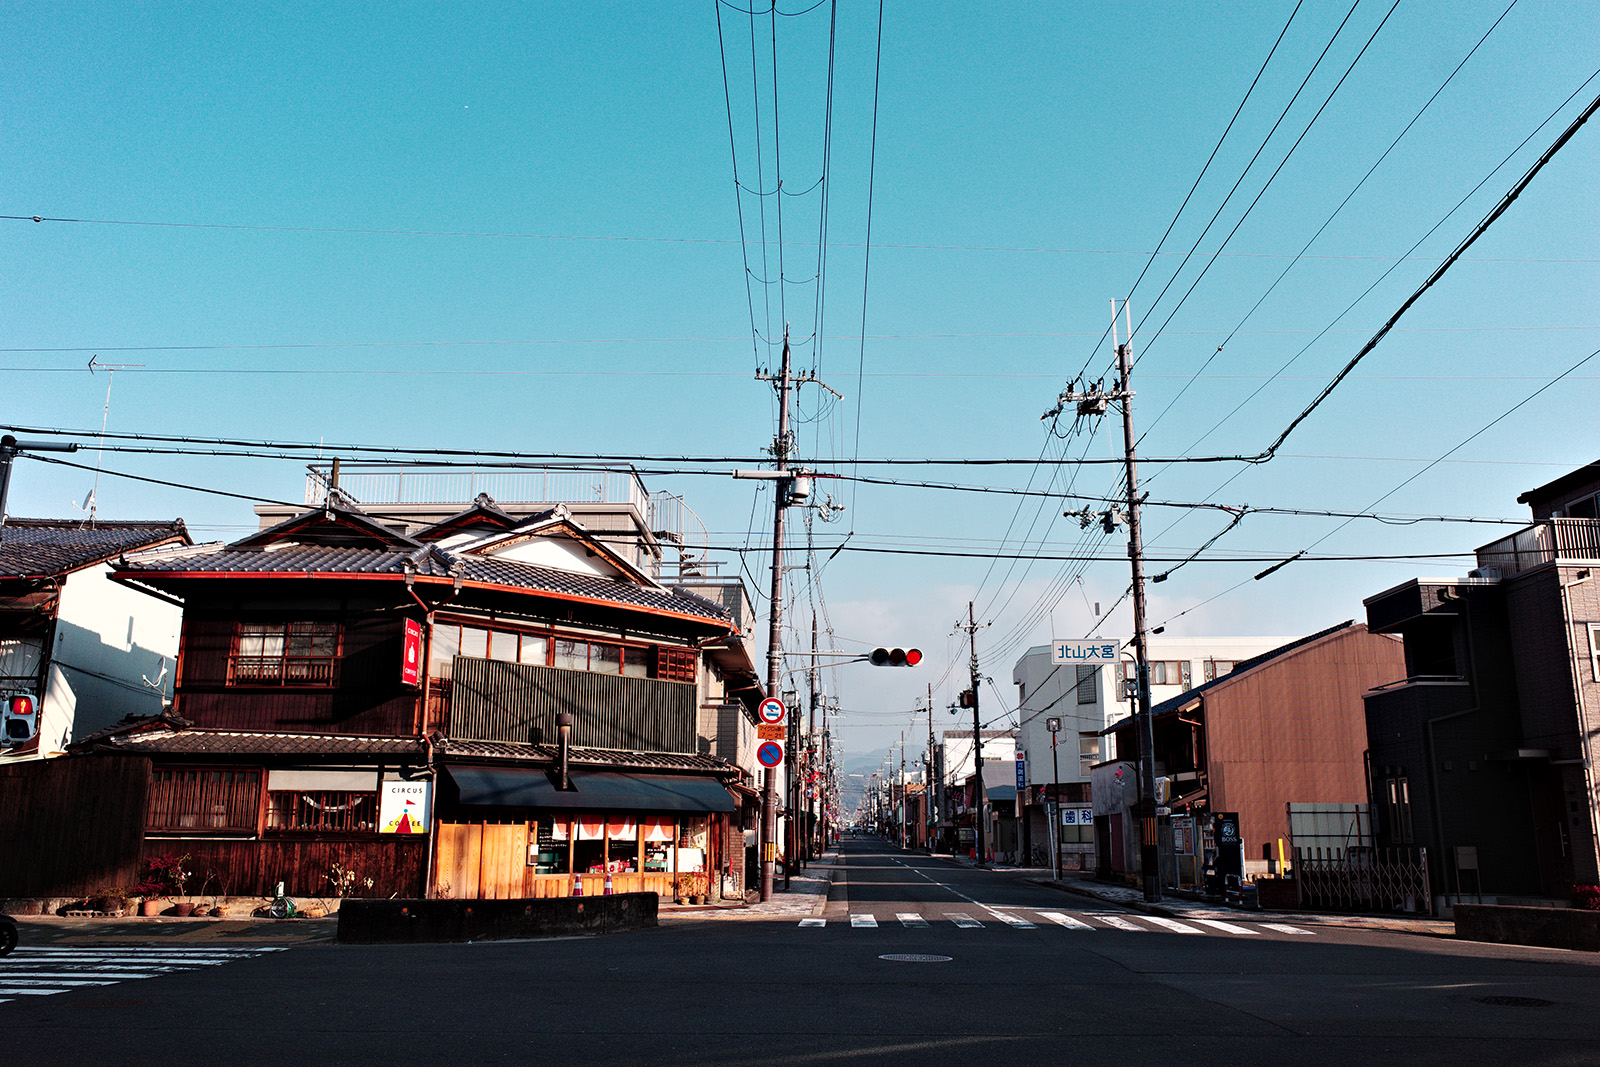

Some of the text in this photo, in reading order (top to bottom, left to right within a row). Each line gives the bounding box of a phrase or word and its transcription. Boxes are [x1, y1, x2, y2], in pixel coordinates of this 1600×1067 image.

[1058, 644, 1115, 659] 北山大宮
[1065, 810, 1093, 824] 歯科
